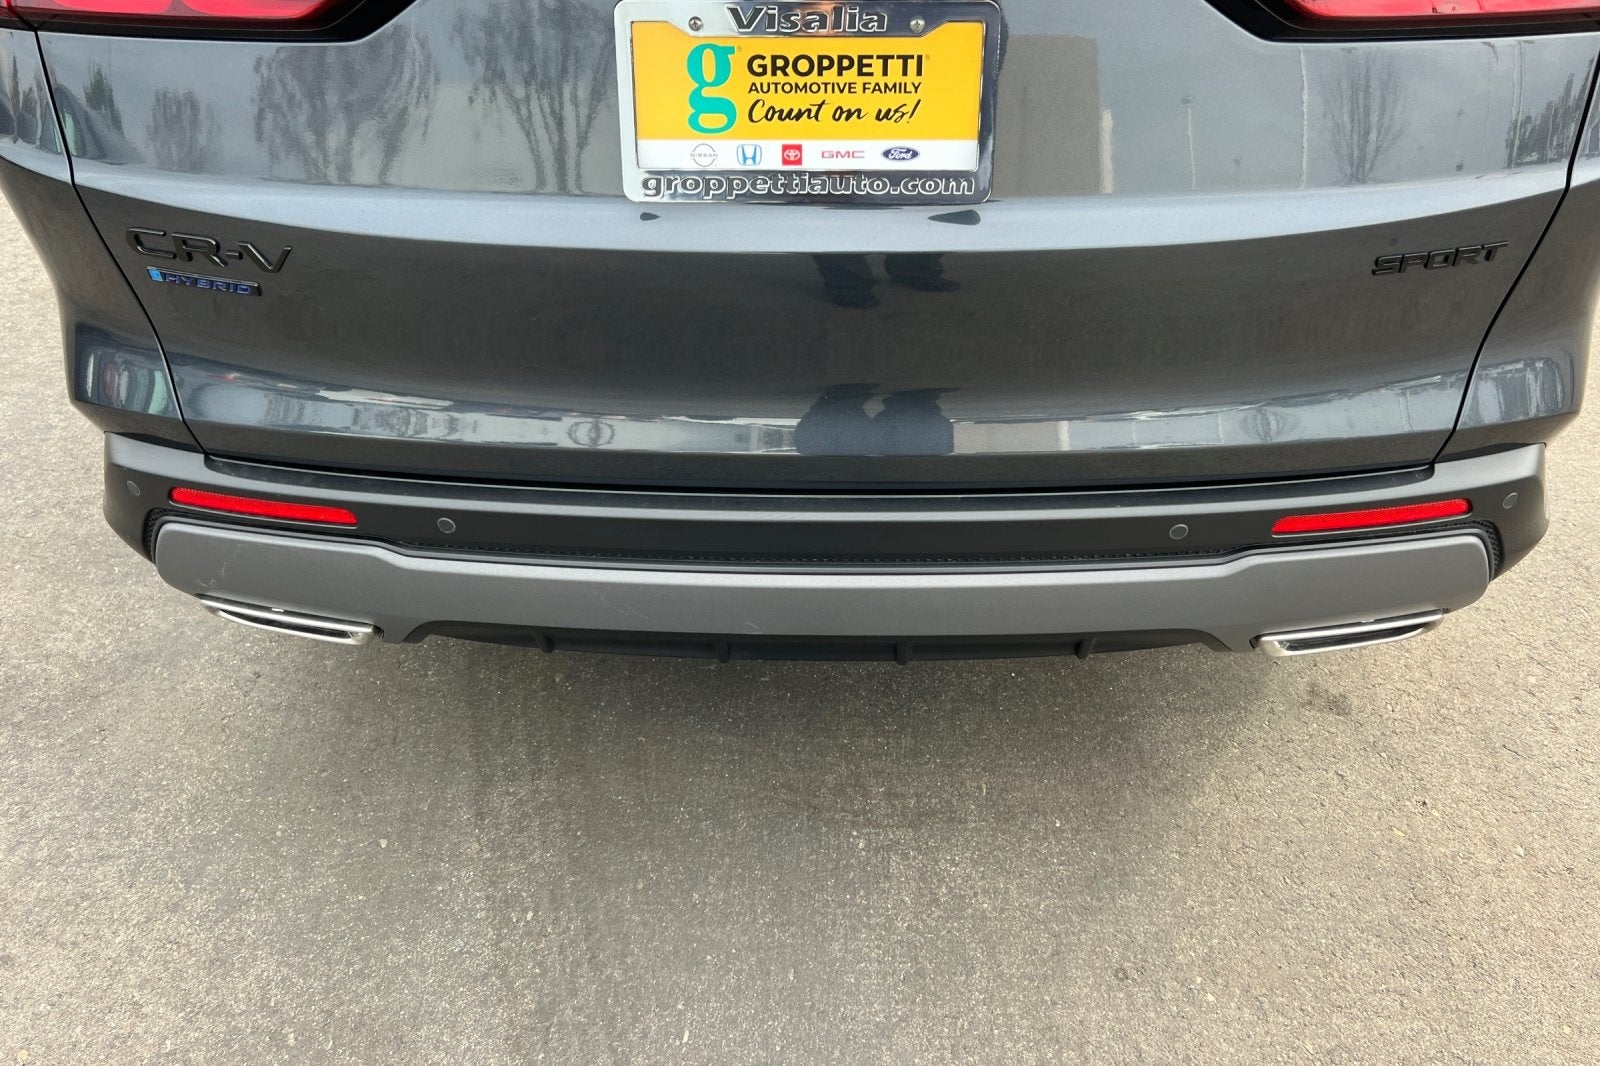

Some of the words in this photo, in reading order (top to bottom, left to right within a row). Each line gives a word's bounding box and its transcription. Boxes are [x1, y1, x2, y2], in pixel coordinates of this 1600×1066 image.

[727, 5, 888, 33] Visalia
[746, 54, 923, 77] GROPPETTI
[747, 82, 857, 95] AUTOMOTIVE
[862, 82, 921, 95] FAMILY
[747, 98, 831, 124] Count
[832, 108, 866, 122] on
[875, 98, 920, 124] us!
[820, 150, 865, 159] GMC
[886, 146, 915, 161] Ford
[640, 173, 975, 200] groppettiauto.com
[125, 226, 293, 273] CR-V
[1371, 240, 1510, 276] SPORT
[164, 273, 251, 295] HYBRID
